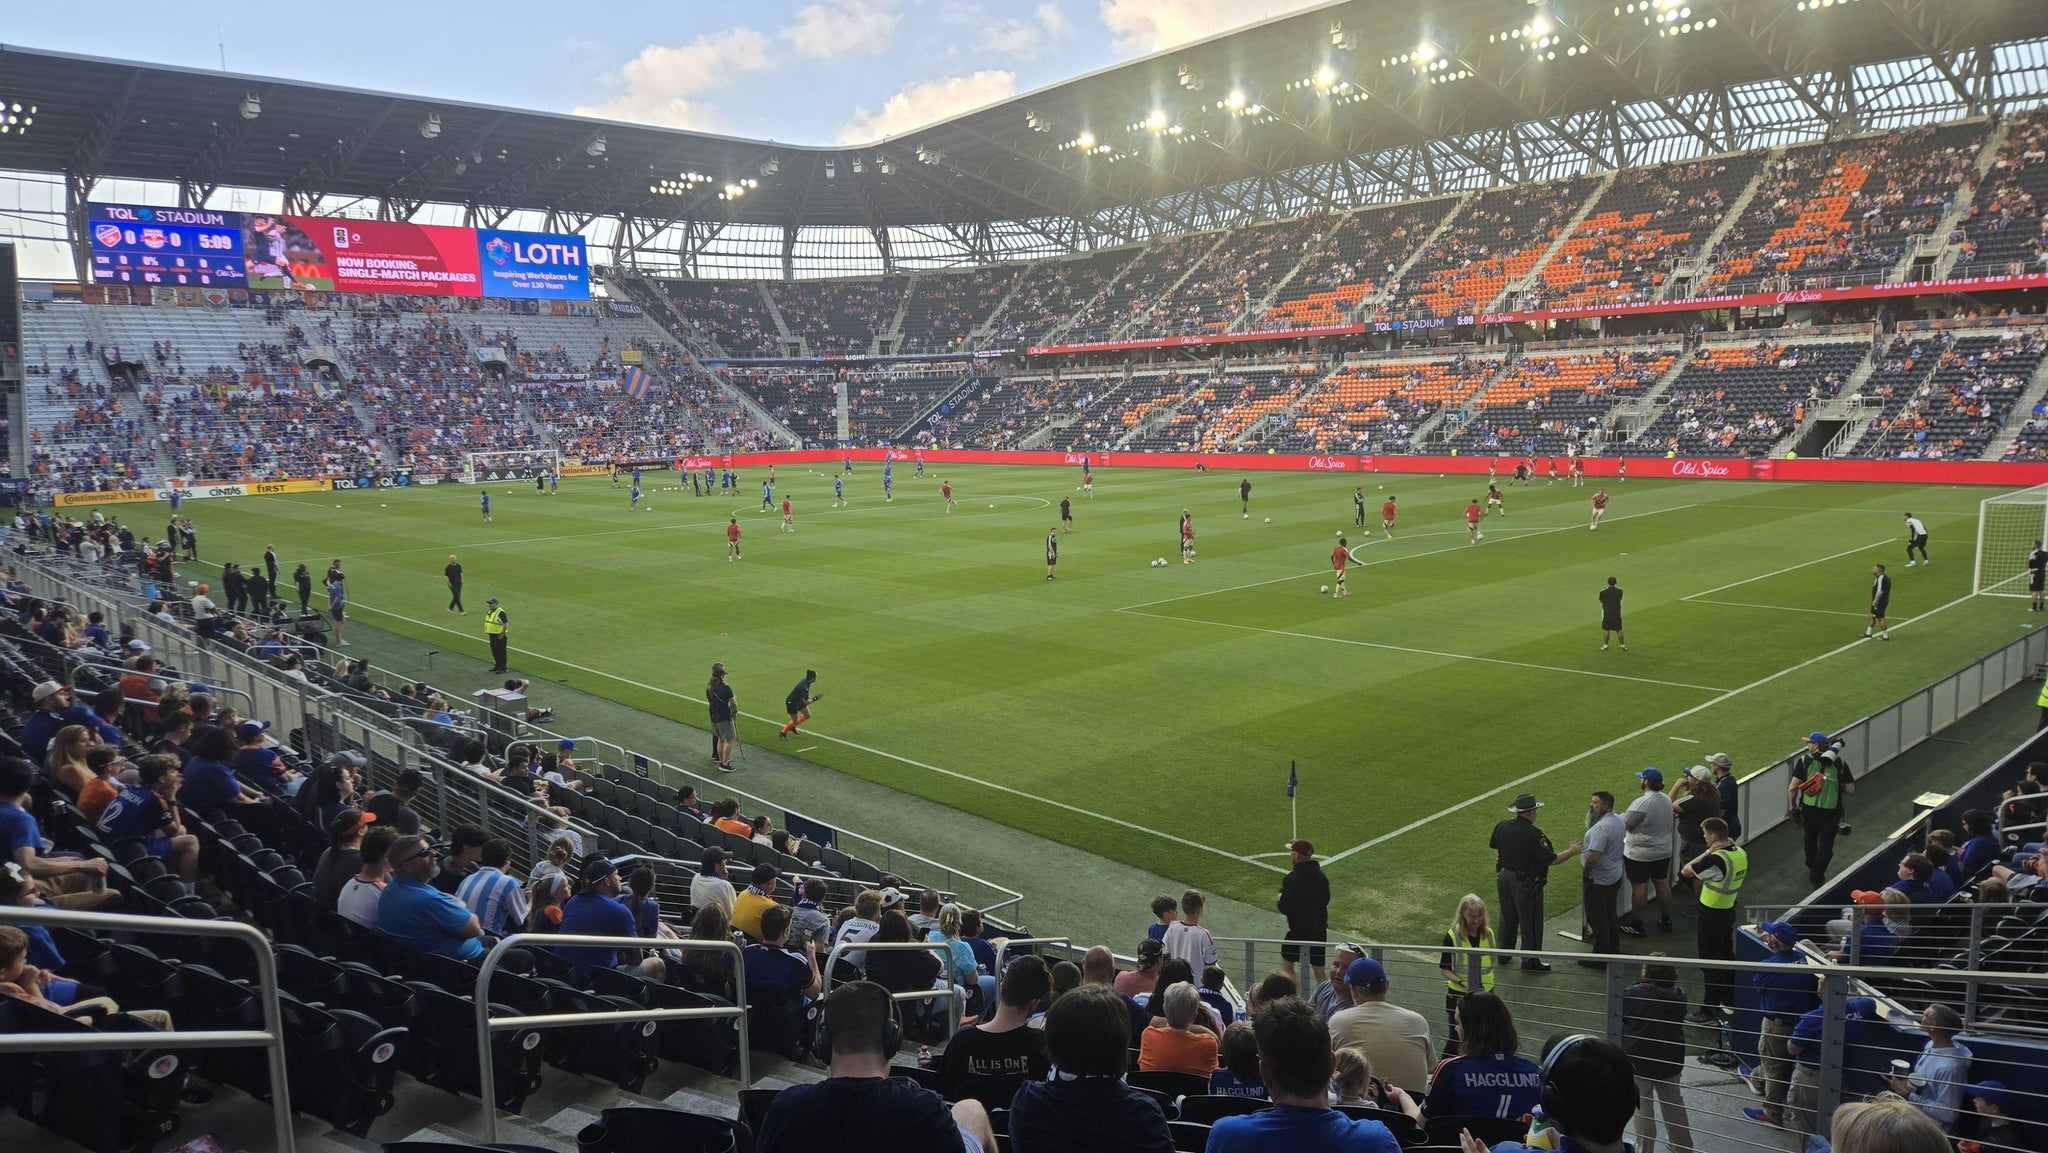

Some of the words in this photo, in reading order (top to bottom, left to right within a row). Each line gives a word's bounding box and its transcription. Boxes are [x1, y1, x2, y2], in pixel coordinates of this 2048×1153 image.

[106, 207, 138, 220] TQL
[156, 210, 224, 226] STADIUM
[125, 230, 136, 245] 0
[170, 232, 181, 247] 0
[199, 234, 232, 250] 5:09
[513, 242, 580, 266] LOTH
[336, 257, 364, 267] NOW
[366, 259, 418, 270] BOOKING:
[338, 267, 419, 280] SINGLE-MATCH
[421, 272, 476, 283] PACKAGES
[493, 270, 527, 279] Inspiring
[527, 271, 567, 281] Workplaces
[568, 273, 579, 281] for
[512, 281, 530, 289] Over
[545, 282, 564, 290] Years
[1777, 291, 1799, 303] Old
[1798, 291, 1822, 303] Spice
[1375, 322, 1392, 332] TQL
[1402, 318, 1444, 330] STADIUM
[1457, 315, 1474, 326] 5:09
[1480, 313, 1495, 324] Old
[1495, 313, 1513, 323] Spice
[927, 411, 943, 426] TQL
[949, 379, 980, 410] STADIUM
[1065, 454, 1077, 464] Old
[1308, 456, 1324, 469] Old
[1324, 456, 1345, 470] Spice
[1672, 460, 1697, 475] Old
[1697, 461, 1729, 477] Spice
[334, 479, 358, 489] TQL
[63, 492, 118, 504] Continental
[127, 491, 148, 500] Tire
[968, 1055, 988, 1073] ALL
[990, 1060, 1001, 1069] IS
[1004, 1055, 1029, 1073] ONE
[1464, 1072, 1540, 1088] HAGGLUND
[1216, 1086, 1264, 1097] HAGGLUND
[1495, 1094, 1512, 1119] 11
[159, 1120, 172, 1133] 10
